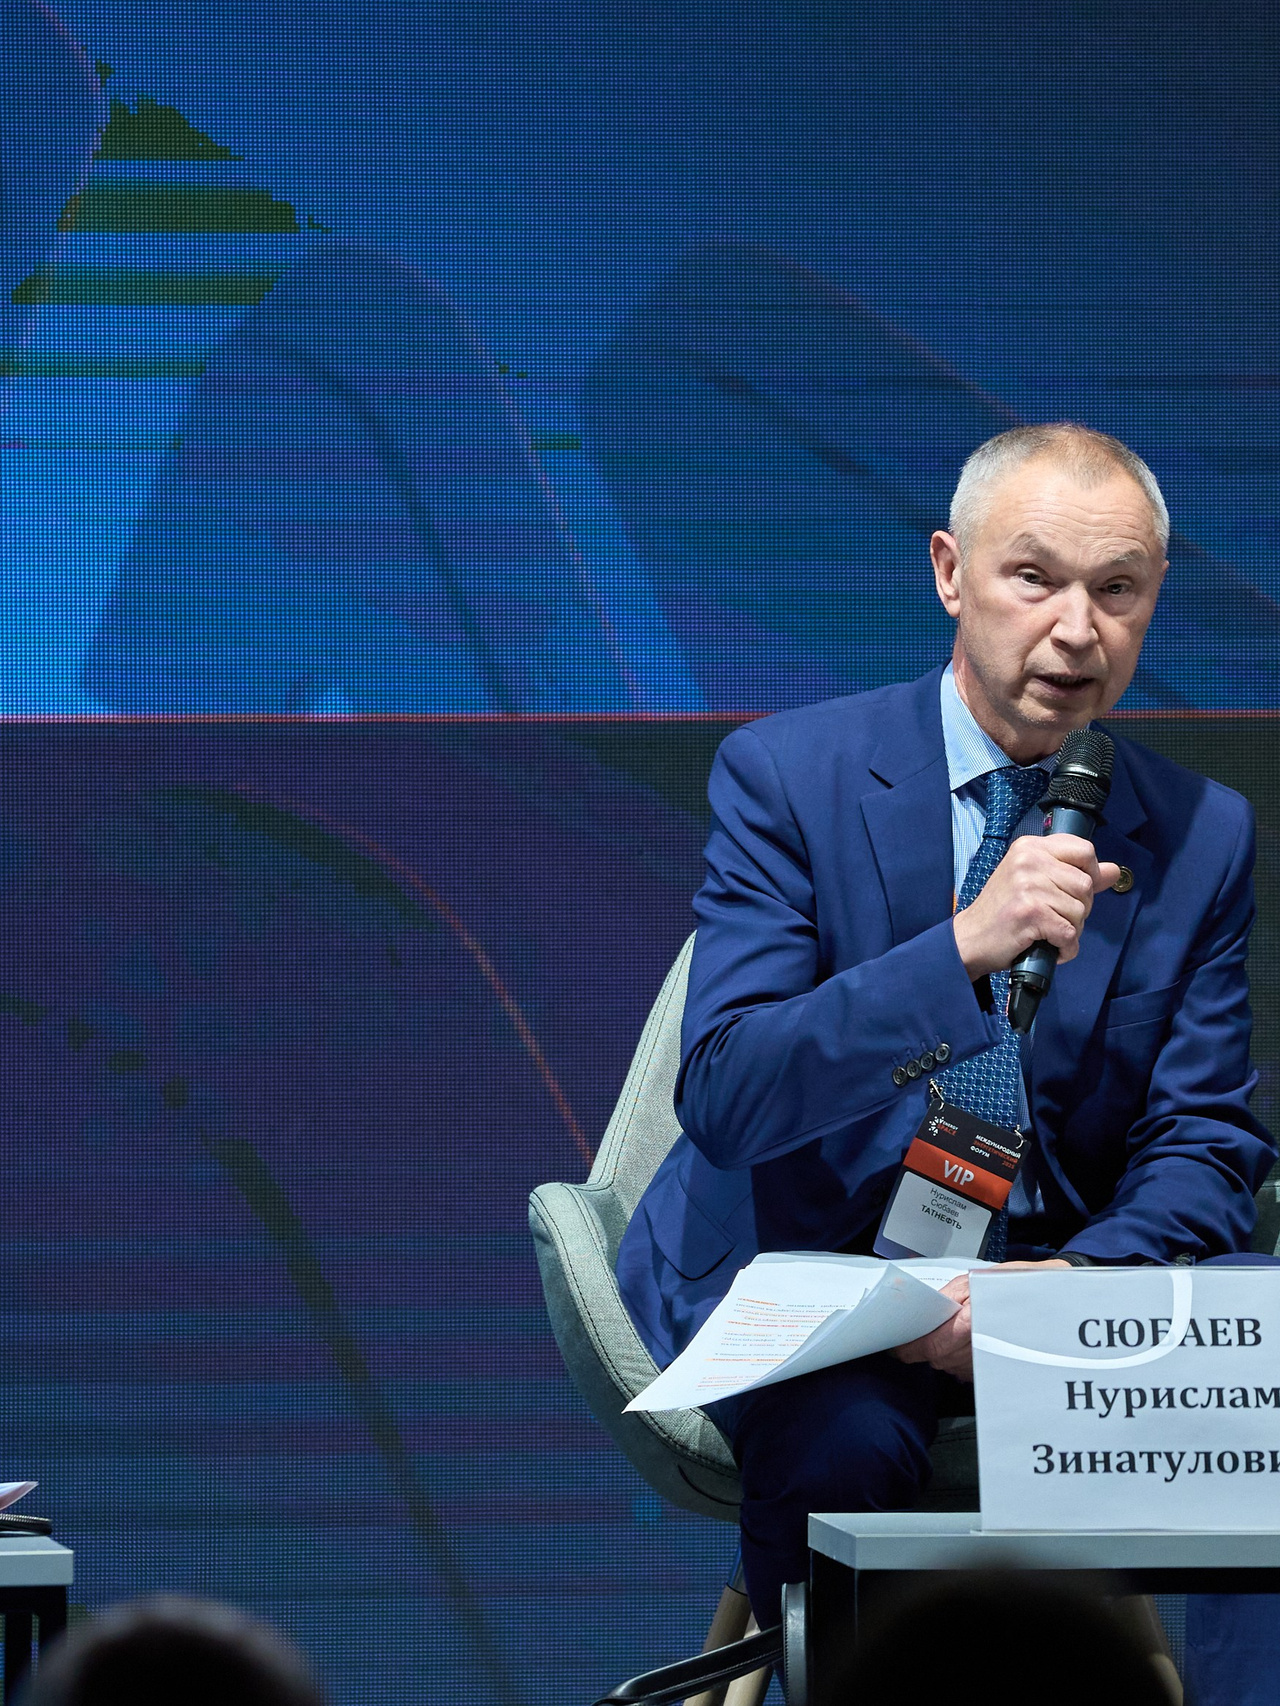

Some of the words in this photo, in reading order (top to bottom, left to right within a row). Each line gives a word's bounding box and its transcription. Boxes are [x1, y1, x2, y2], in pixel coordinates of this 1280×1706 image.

[970, 1145, 990, 1158] ФОРУМ
[975, 1134, 1021, 1159] МЕЖДУНАРОДНЫЙ
[944, 1159, 975, 1186] VIP
[930, 1187, 967, 1211] Нурислам
[930, 1198, 960, 1218] Сюбаев
[921, 1204, 962, 1230] ТАТНЕФТЬ
[1077, 1317, 1263, 1349] СЮБАЕВ
